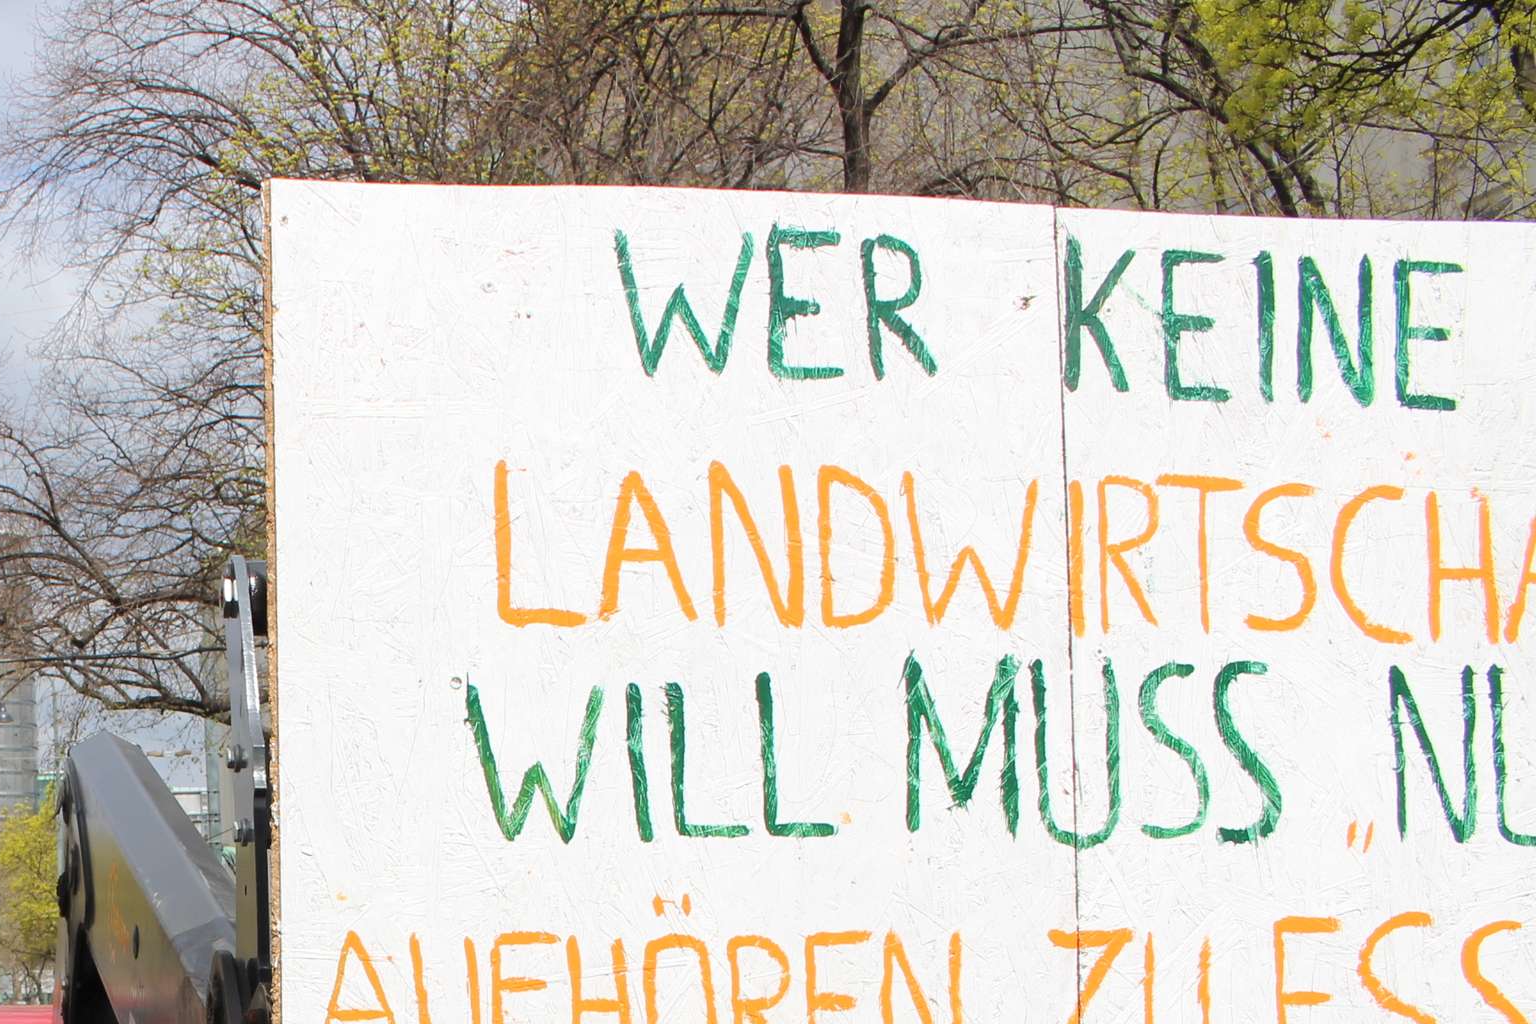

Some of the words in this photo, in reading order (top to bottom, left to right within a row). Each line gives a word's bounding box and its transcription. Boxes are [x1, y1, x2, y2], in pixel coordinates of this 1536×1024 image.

[614, 220, 939, 381] WER
[1064, 233, 1465, 411] KEINE
[465, 672, 838, 844] WILL
[898, 649, 1283, 850] MUSS
